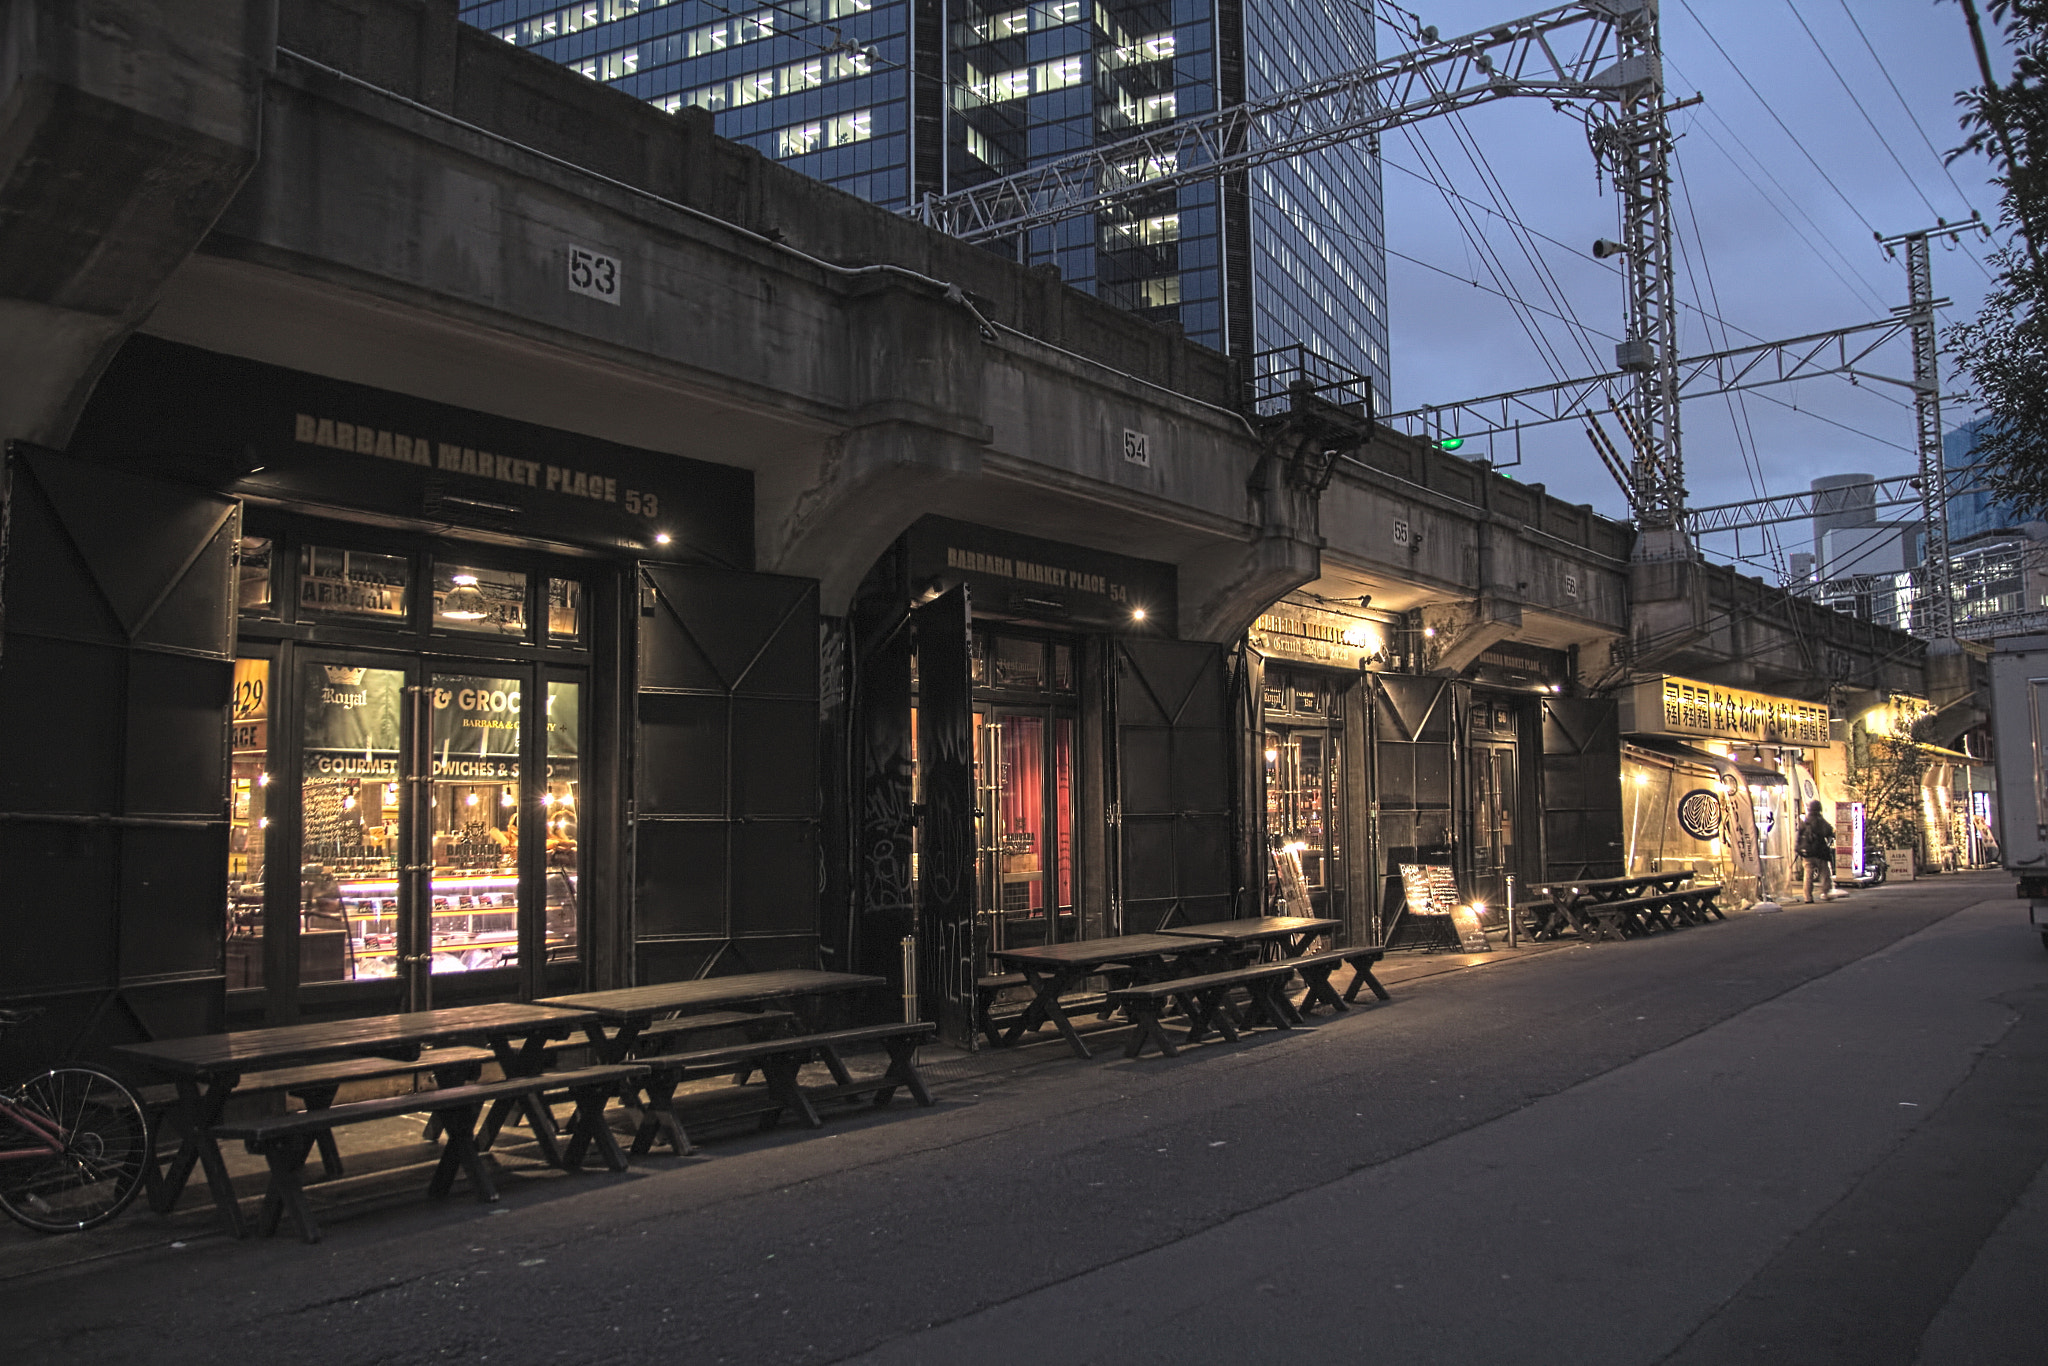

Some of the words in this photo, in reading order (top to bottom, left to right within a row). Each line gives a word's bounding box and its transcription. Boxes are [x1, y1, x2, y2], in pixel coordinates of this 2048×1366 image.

[571, 249, 615, 295] 53
[1125, 431, 1147, 463] 54
[295, 413, 432, 467] BARBARA
[437, 442, 541, 488] MARKET
[546, 465, 617, 503] PLACE
[625, 489, 659, 518] 53
[1395, 520, 1407, 543] 55
[948, 547, 1013, 578] BARBARA
[1015, 560, 1067, 587] MARKET
[1070, 571, 1106, 594] PLACE
[1110, 583, 1127, 603] 54
[322, 687, 368, 710] Royal
[458, 688, 557, 716] GROCY
[462, 718, 503, 730] BARBARA
[318, 757, 398, 774] GOURMET
[433, 760, 495, 777] DWICHES
[498, 763, 508, 777] &
[321, 845, 384, 858] BARBARA
[446, 844, 502, 857] BARBARA
